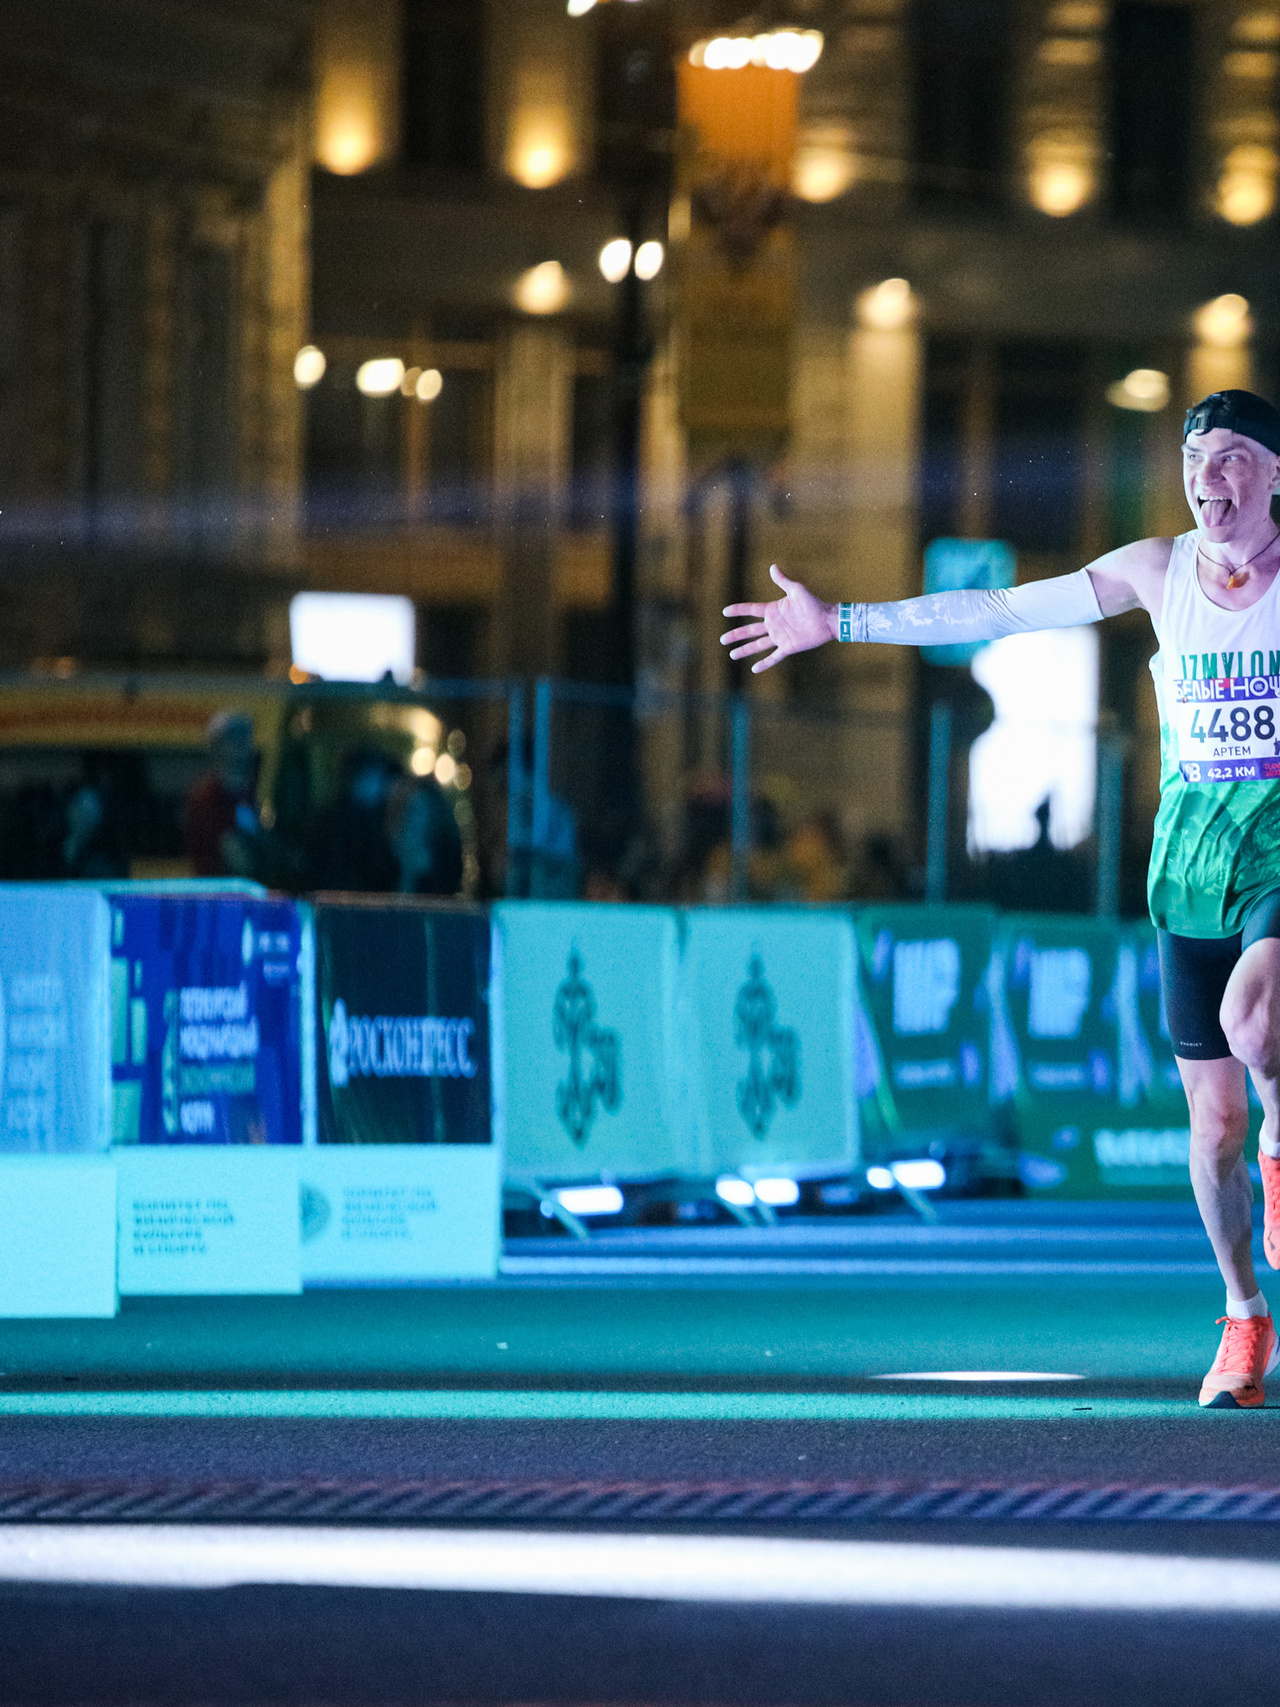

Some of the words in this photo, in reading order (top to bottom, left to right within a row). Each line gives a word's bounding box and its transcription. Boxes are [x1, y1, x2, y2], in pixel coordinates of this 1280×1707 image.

[1174, 678, 1225, 700] БЕЛЫЕ
[1190, 705, 1275, 743] 4488
[1212, 746, 1251, 757] АРТЕМ
[1207, 767, 1233, 779] 42,2
